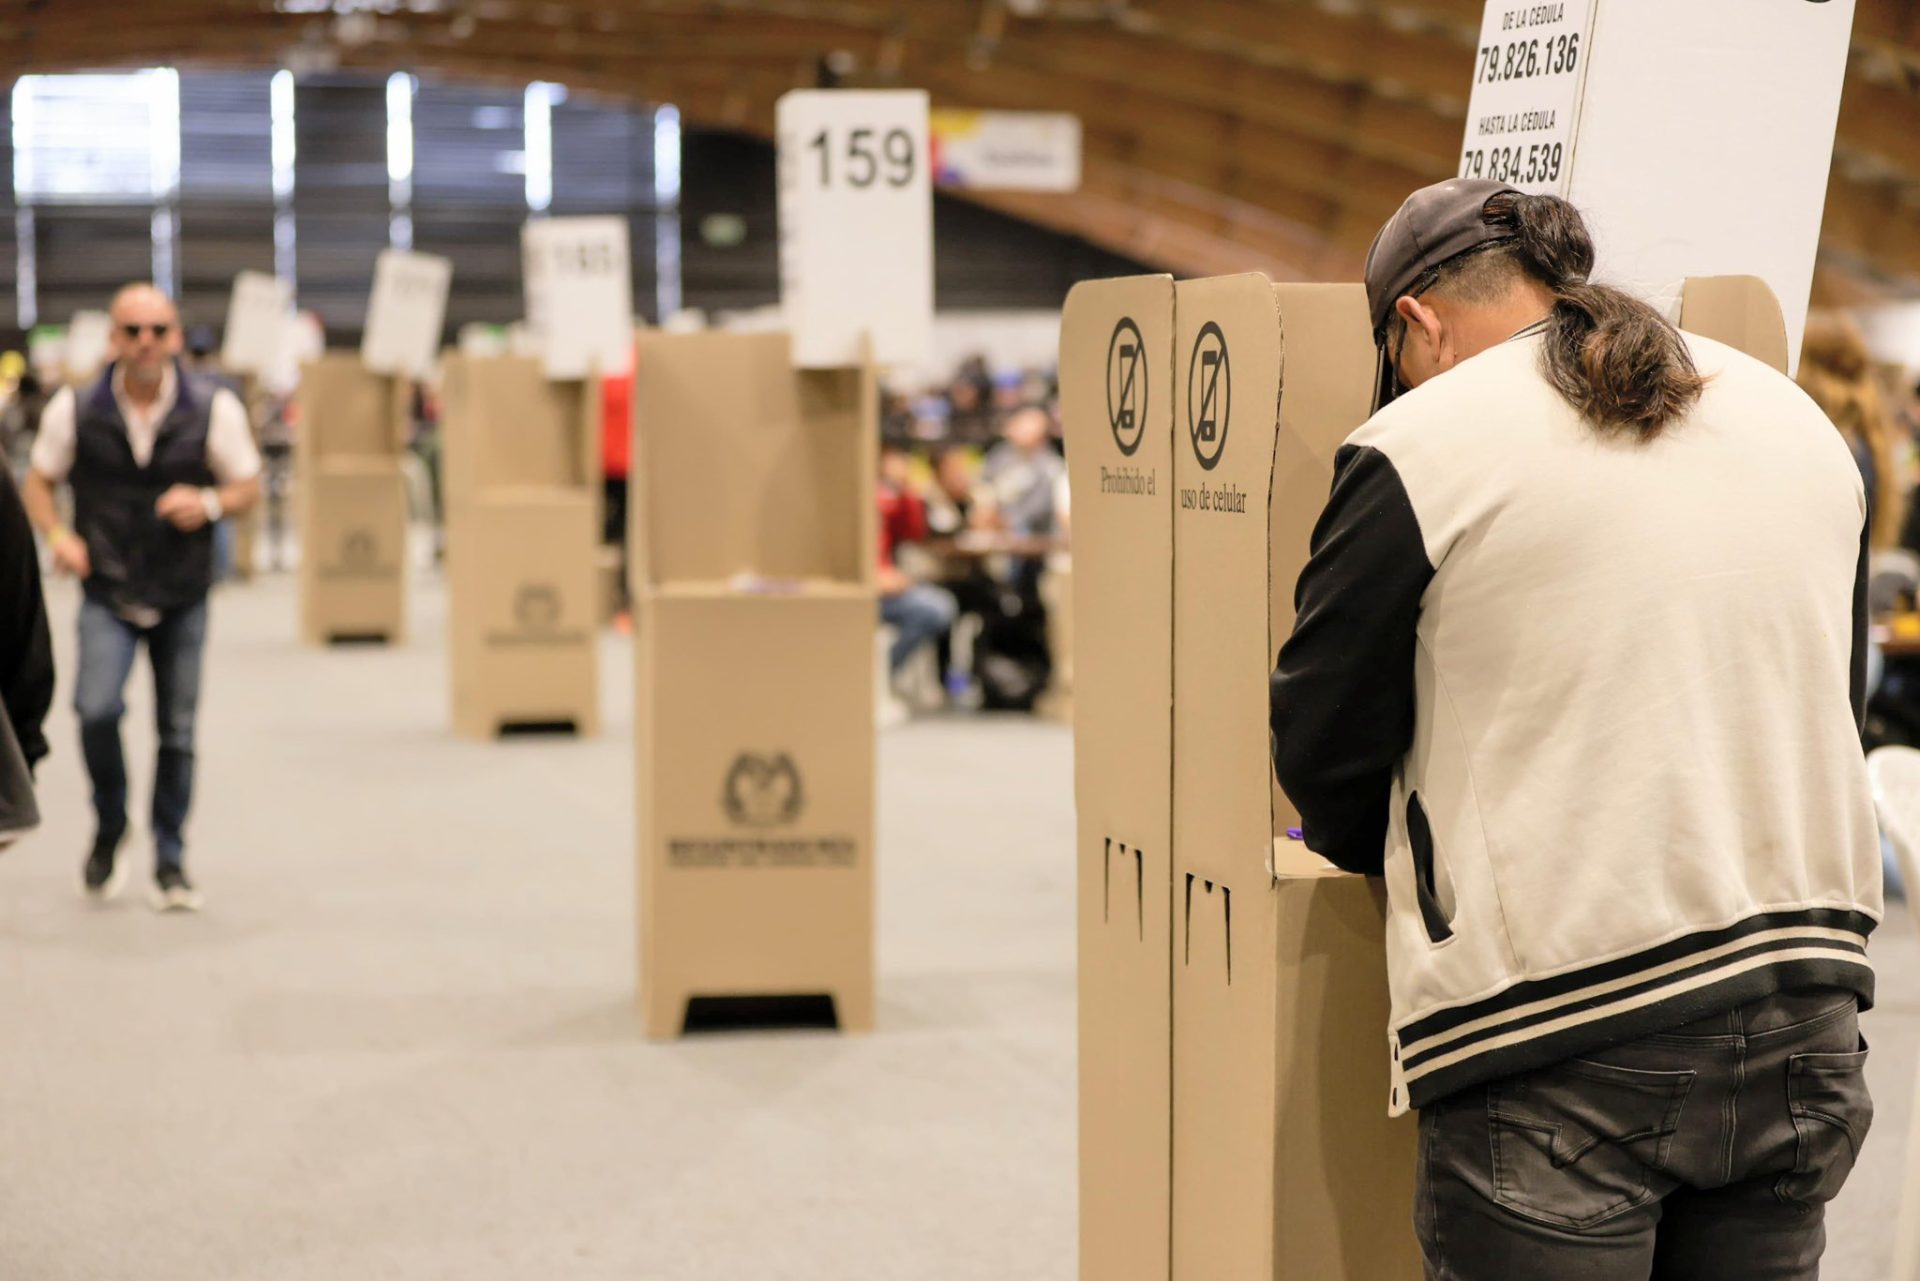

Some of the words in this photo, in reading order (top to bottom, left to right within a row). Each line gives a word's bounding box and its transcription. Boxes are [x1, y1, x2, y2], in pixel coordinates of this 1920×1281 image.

[1502, 11, 1515, 31] DE
[1515, 8, 1527, 29] LA
[1478, 32, 1580, 84] 79.826.136
[1478, 114, 1506, 136] HASTA
[1507, 113, 1519, 133] LA
[809, 127, 916, 188] 159
[1464, 142, 1563, 184] 79834.539
[1100, 466, 1146, 495] Prohibido
[1147, 467, 1156, 496] el
[1180, 488, 1198, 511] uso
[1199, 482, 1211, 511] de
[1212, 483, 1247, 514] celular
